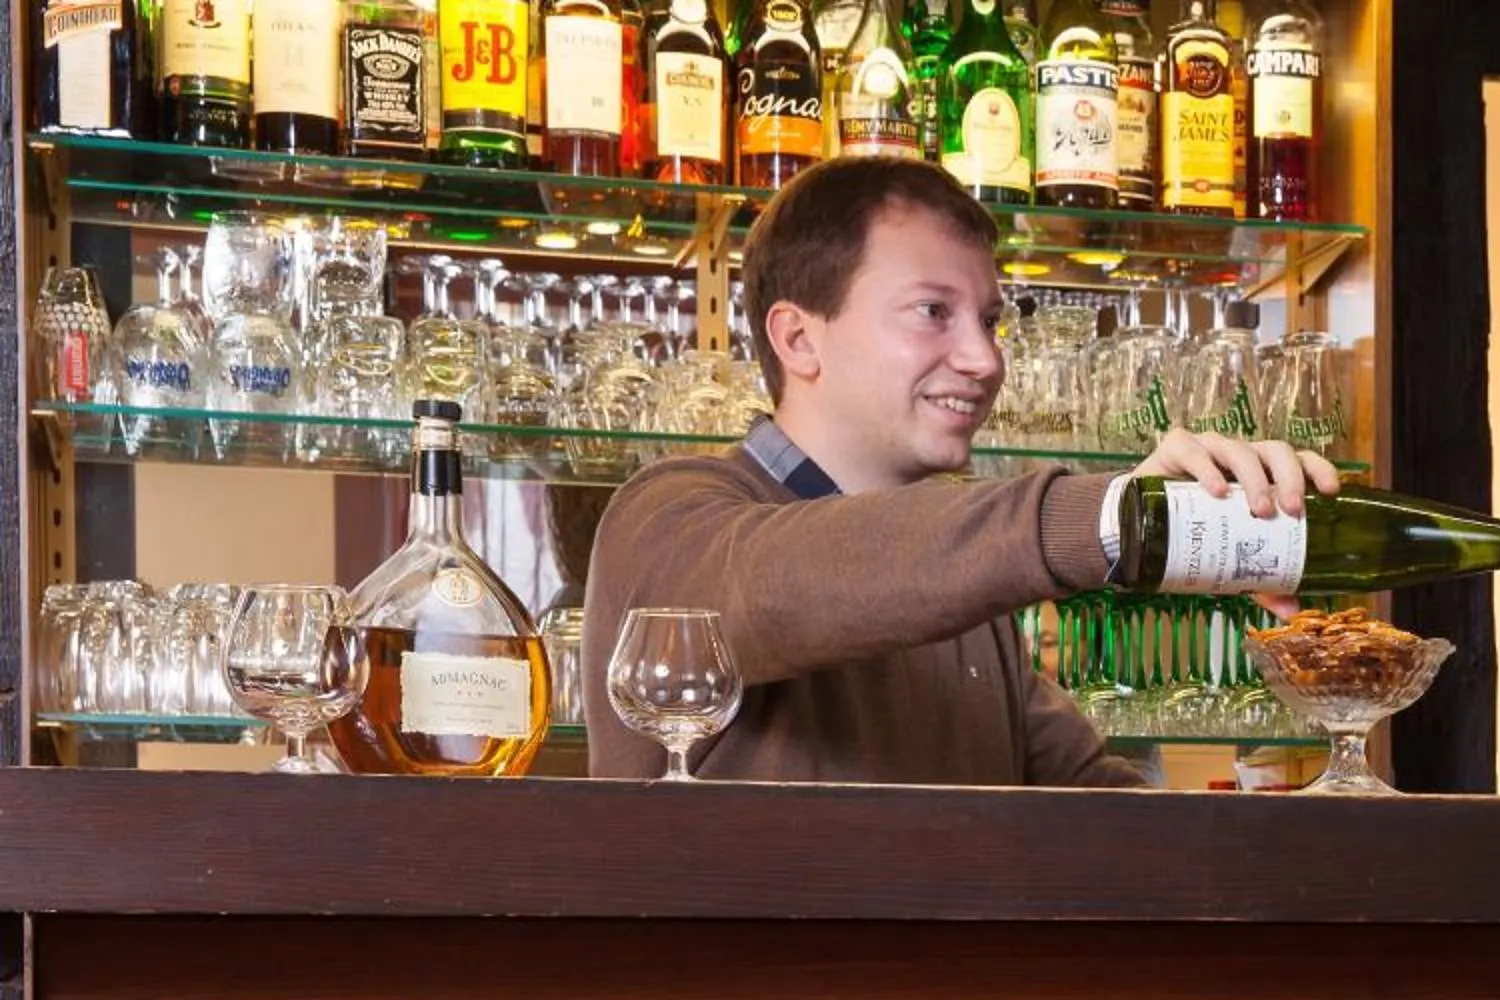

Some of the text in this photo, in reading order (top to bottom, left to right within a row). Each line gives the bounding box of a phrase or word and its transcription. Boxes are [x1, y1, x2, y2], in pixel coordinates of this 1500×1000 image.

[351, 36, 379, 60] JACK
[451, 21, 517, 85] J&B
[1247, 51, 1319, 76] CAMPARI
[1041, 65, 1120, 89] PASTIS
[1179, 109, 1229, 126] SAINT
[1177, 128, 1230, 142] JAMES
[431, 671, 508, 692] ARMAGNAC
